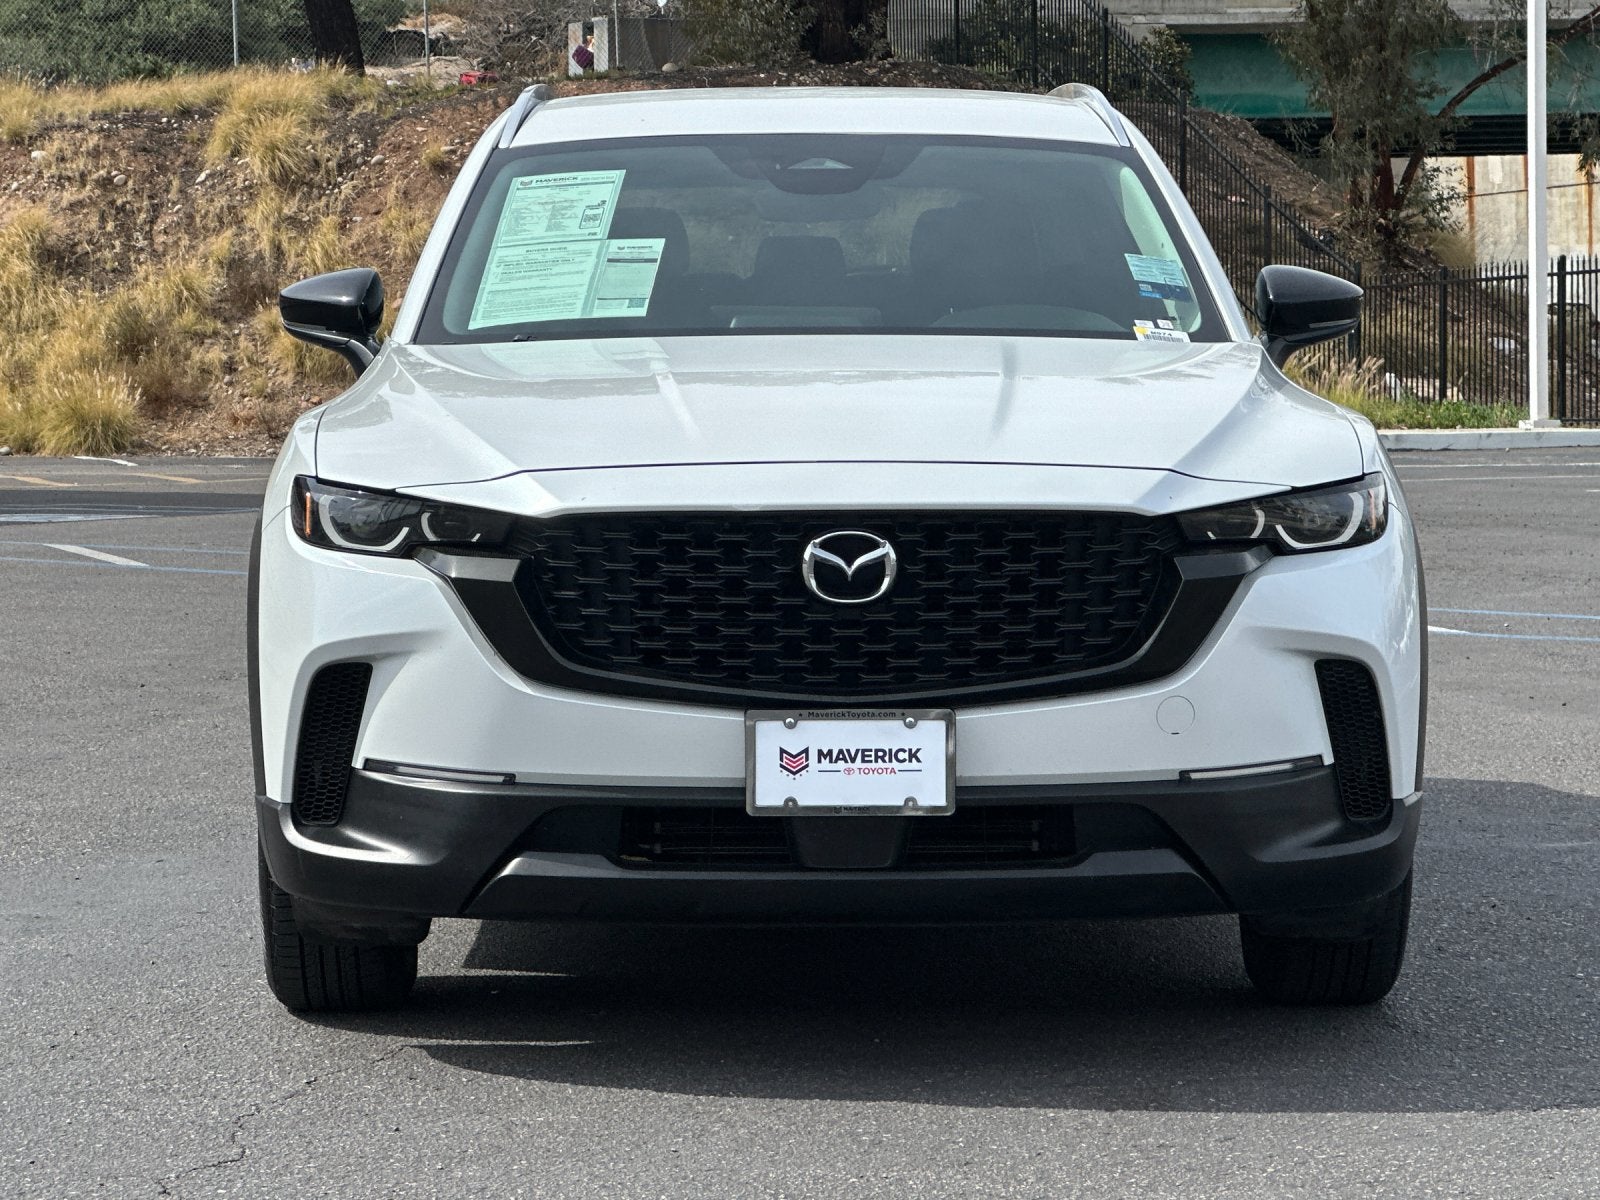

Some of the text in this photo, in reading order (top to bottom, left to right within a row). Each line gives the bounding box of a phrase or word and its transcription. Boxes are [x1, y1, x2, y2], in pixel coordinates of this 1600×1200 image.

[535, 176, 578, 184] MAVERICK
[817, 747, 922, 764] MAVERICK
[857, 767, 897, 775] TOYOTA
